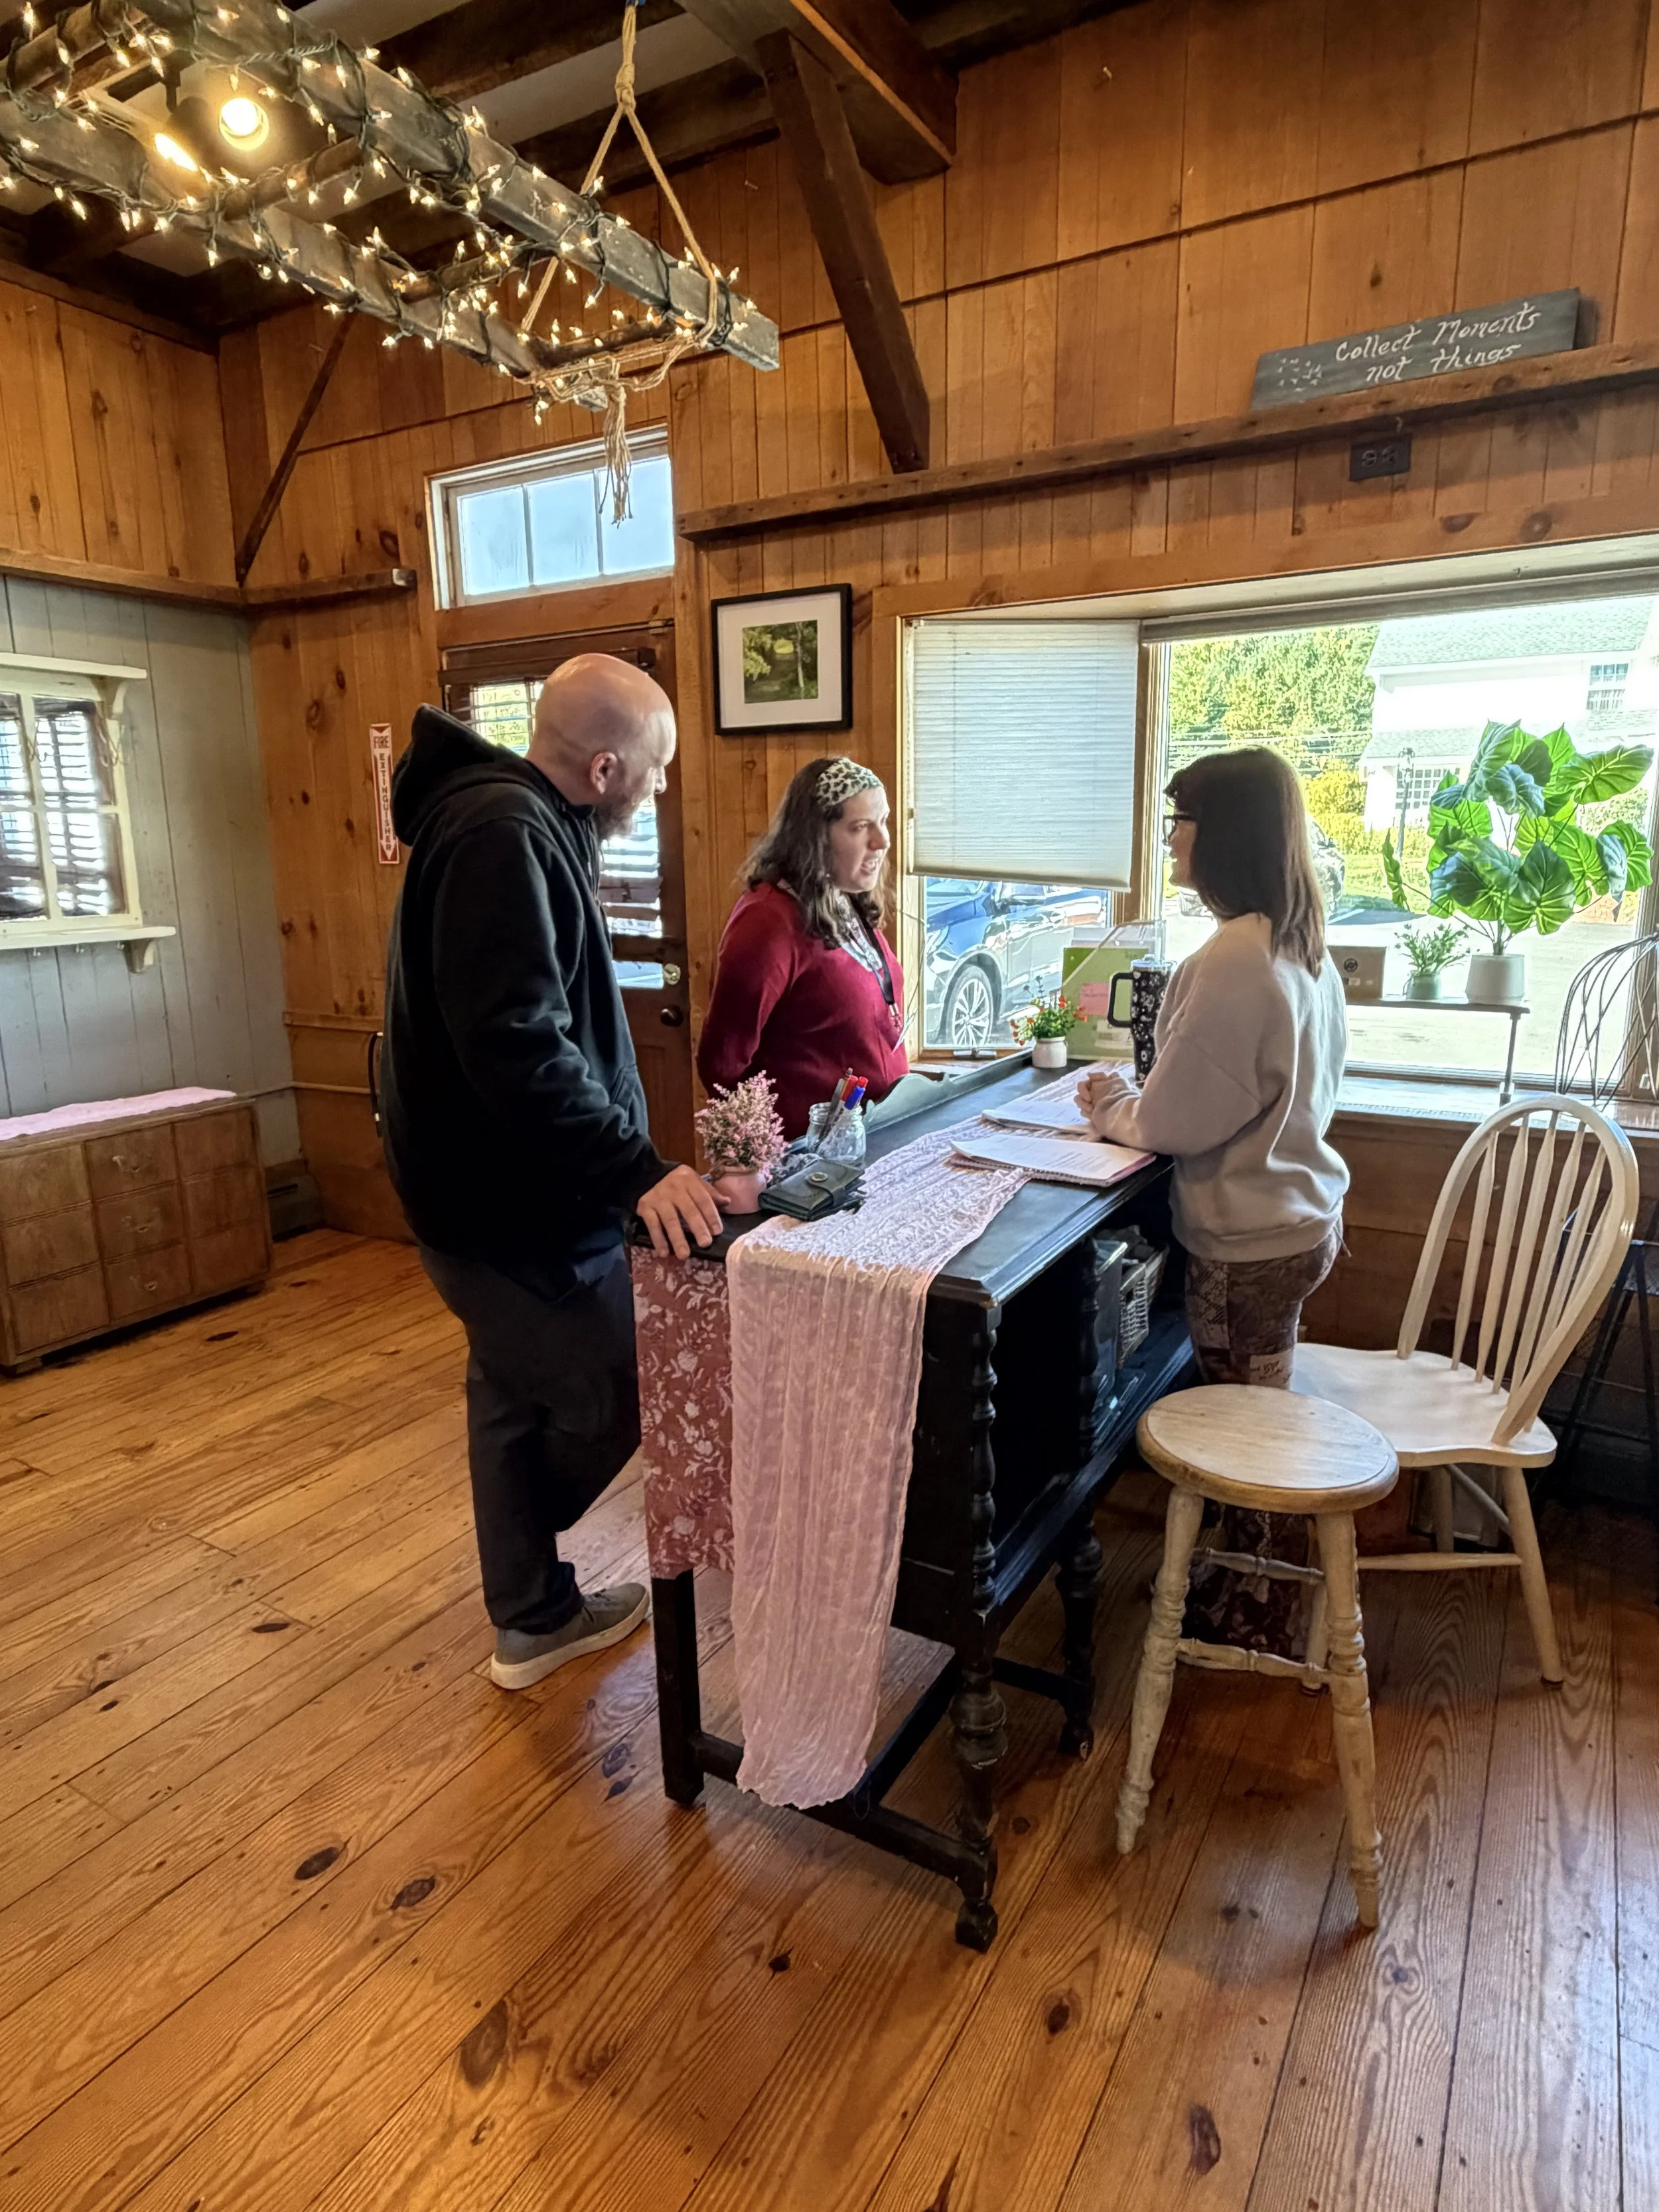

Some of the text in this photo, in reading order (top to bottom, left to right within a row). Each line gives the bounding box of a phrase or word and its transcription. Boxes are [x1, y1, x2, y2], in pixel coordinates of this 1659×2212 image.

[1335, 301, 1542, 362] Collect Moments
[1365, 343, 1522, 384] not things
[374, 735, 390, 749] FIRE
[379, 753, 392, 851] EXTINGUISHER
